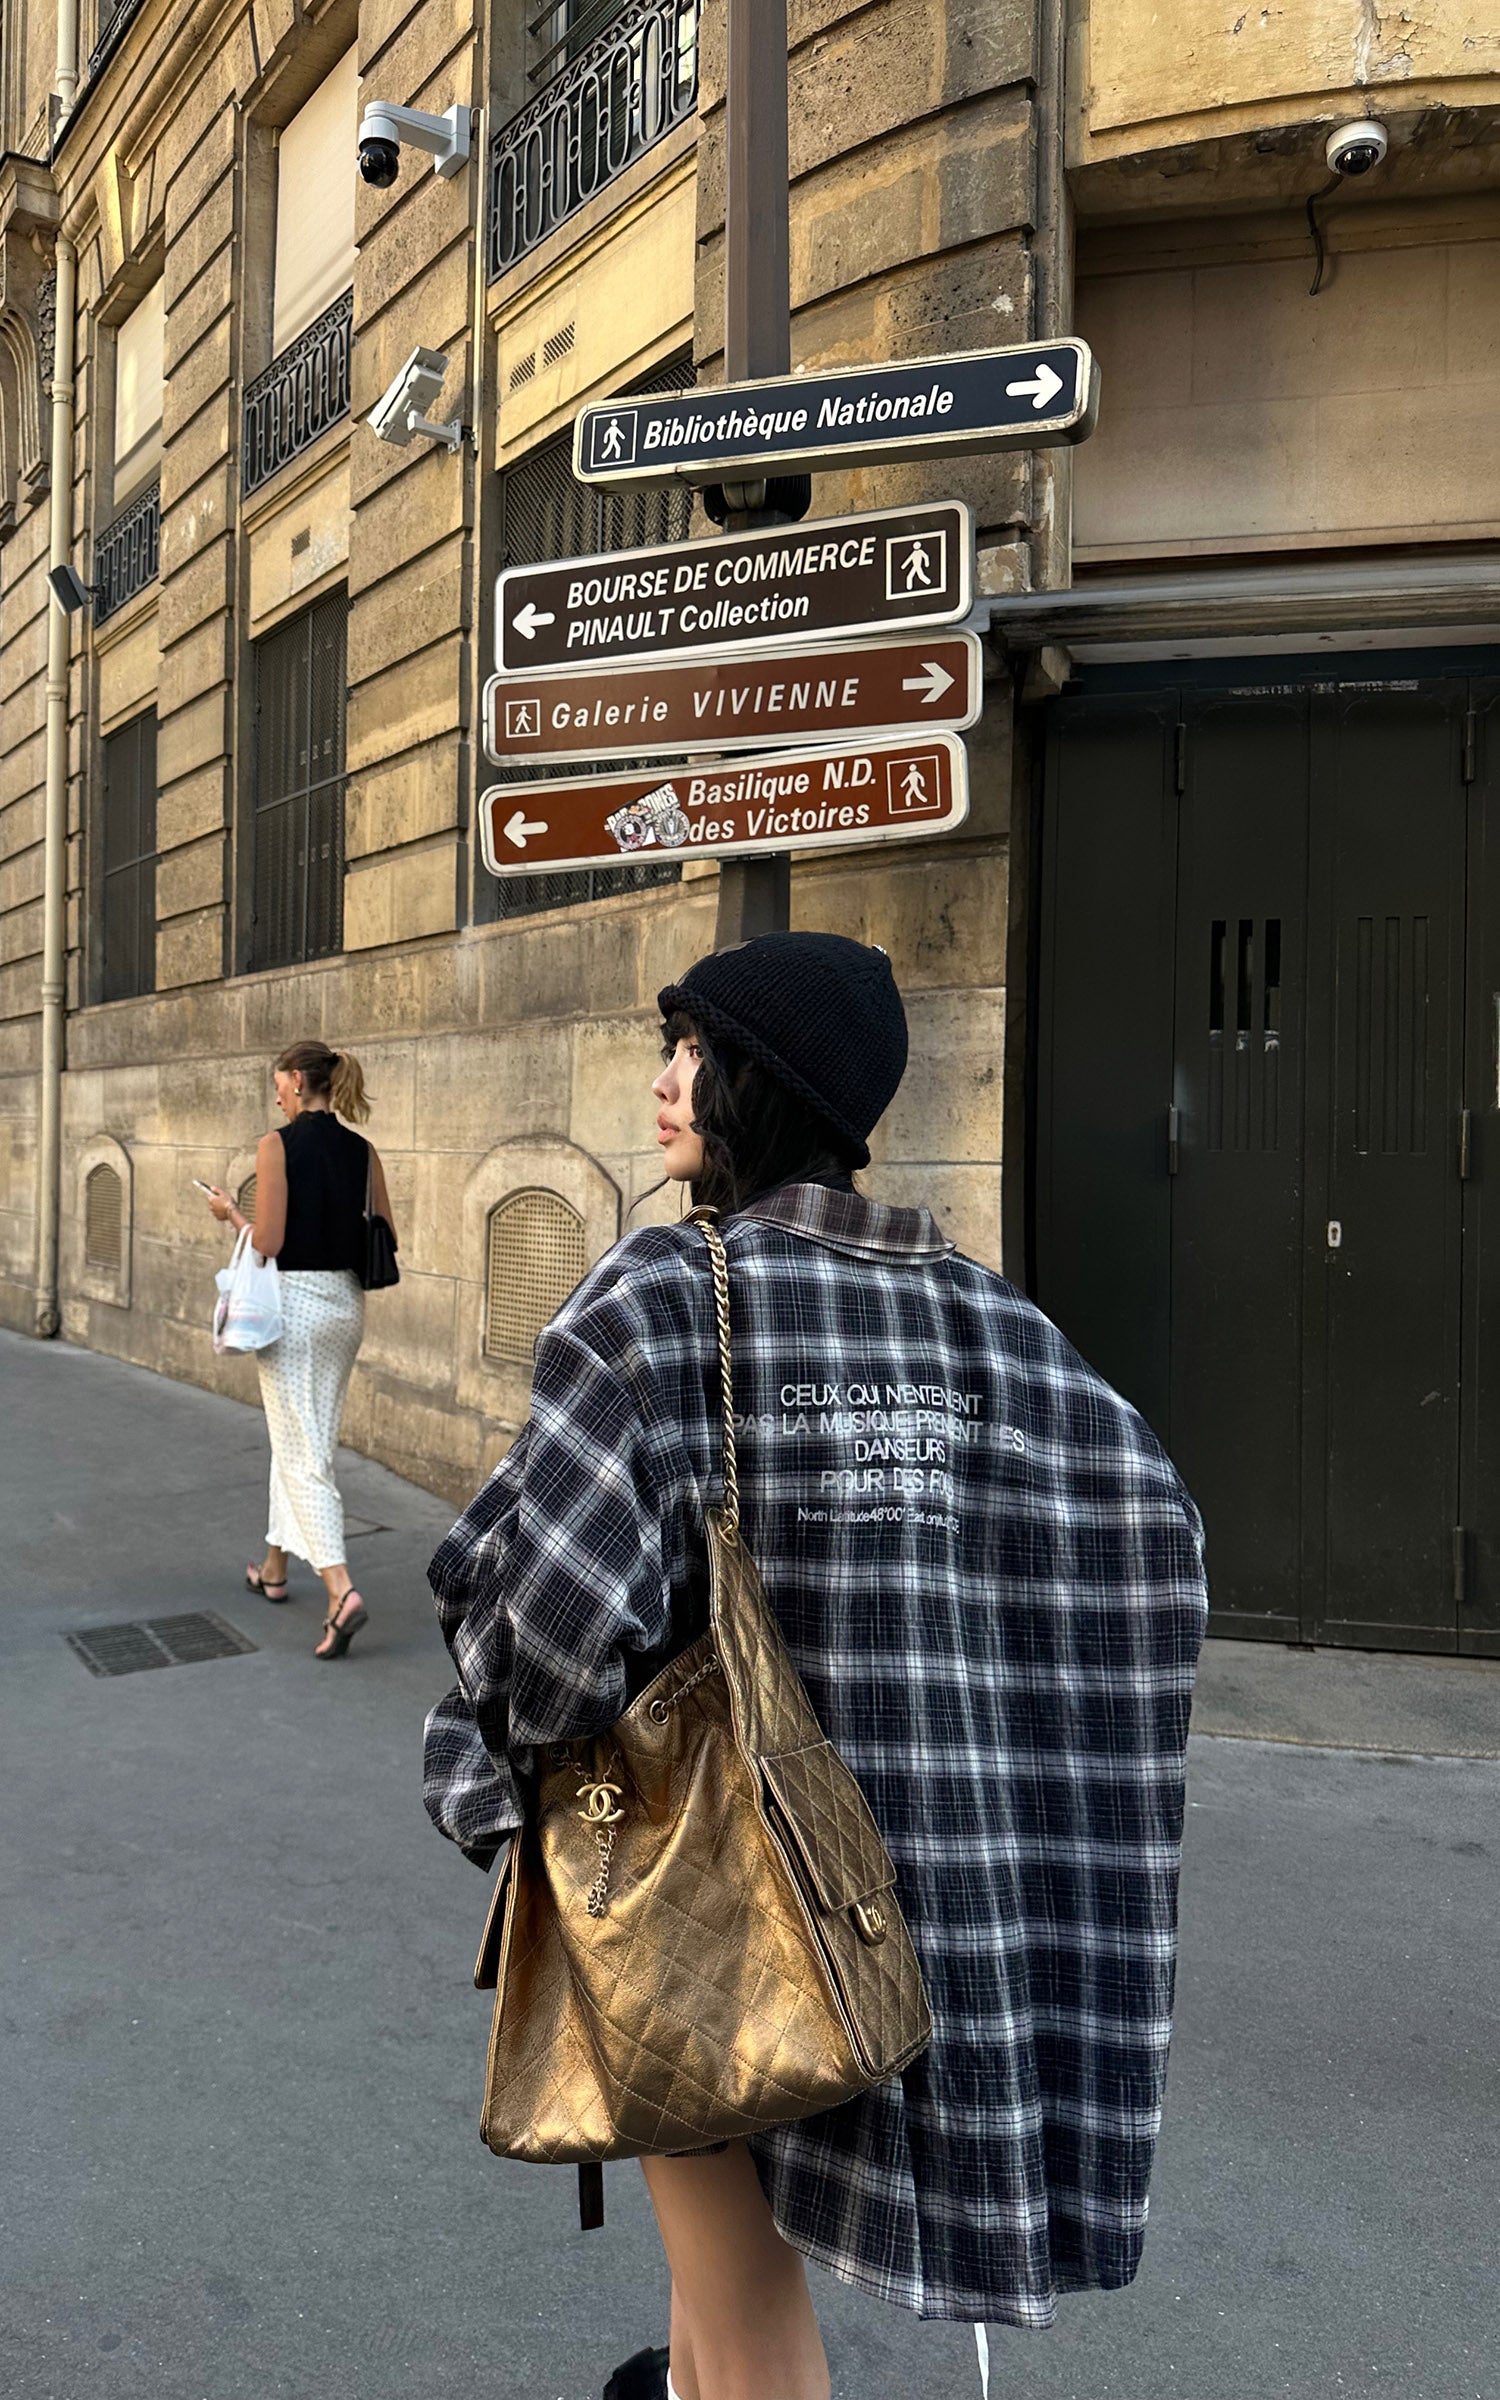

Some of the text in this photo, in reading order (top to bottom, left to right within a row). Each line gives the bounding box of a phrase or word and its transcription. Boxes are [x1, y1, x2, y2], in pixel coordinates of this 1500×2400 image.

[642, 384, 954, 450] Bibliothèque Nationale
[566, 536, 877, 609] BOURSE DE COMMERCE
[566, 592, 810, 649] PINAULT Collection
[551, 678, 860, 729] Galerie VIVIENNE
[687, 758, 877, 807] Basilique N.D.
[689, 814, 736, 843] des
[746, 803, 870, 837] Victoires
[780, 1384, 842, 1407] CEUX
[847, 1383, 880, 1405] QUI
[732, 1413, 775, 1436] PAS
[782, 1412, 811, 1435] LA
[820, 1411, 910, 1434] MUSIQUE
[855, 1437, 946, 1463] DANSEURS
[821, 1469, 884, 1493] POUR
[893, 1467, 925, 1493] DES
[797, 1507, 828, 1522] North
